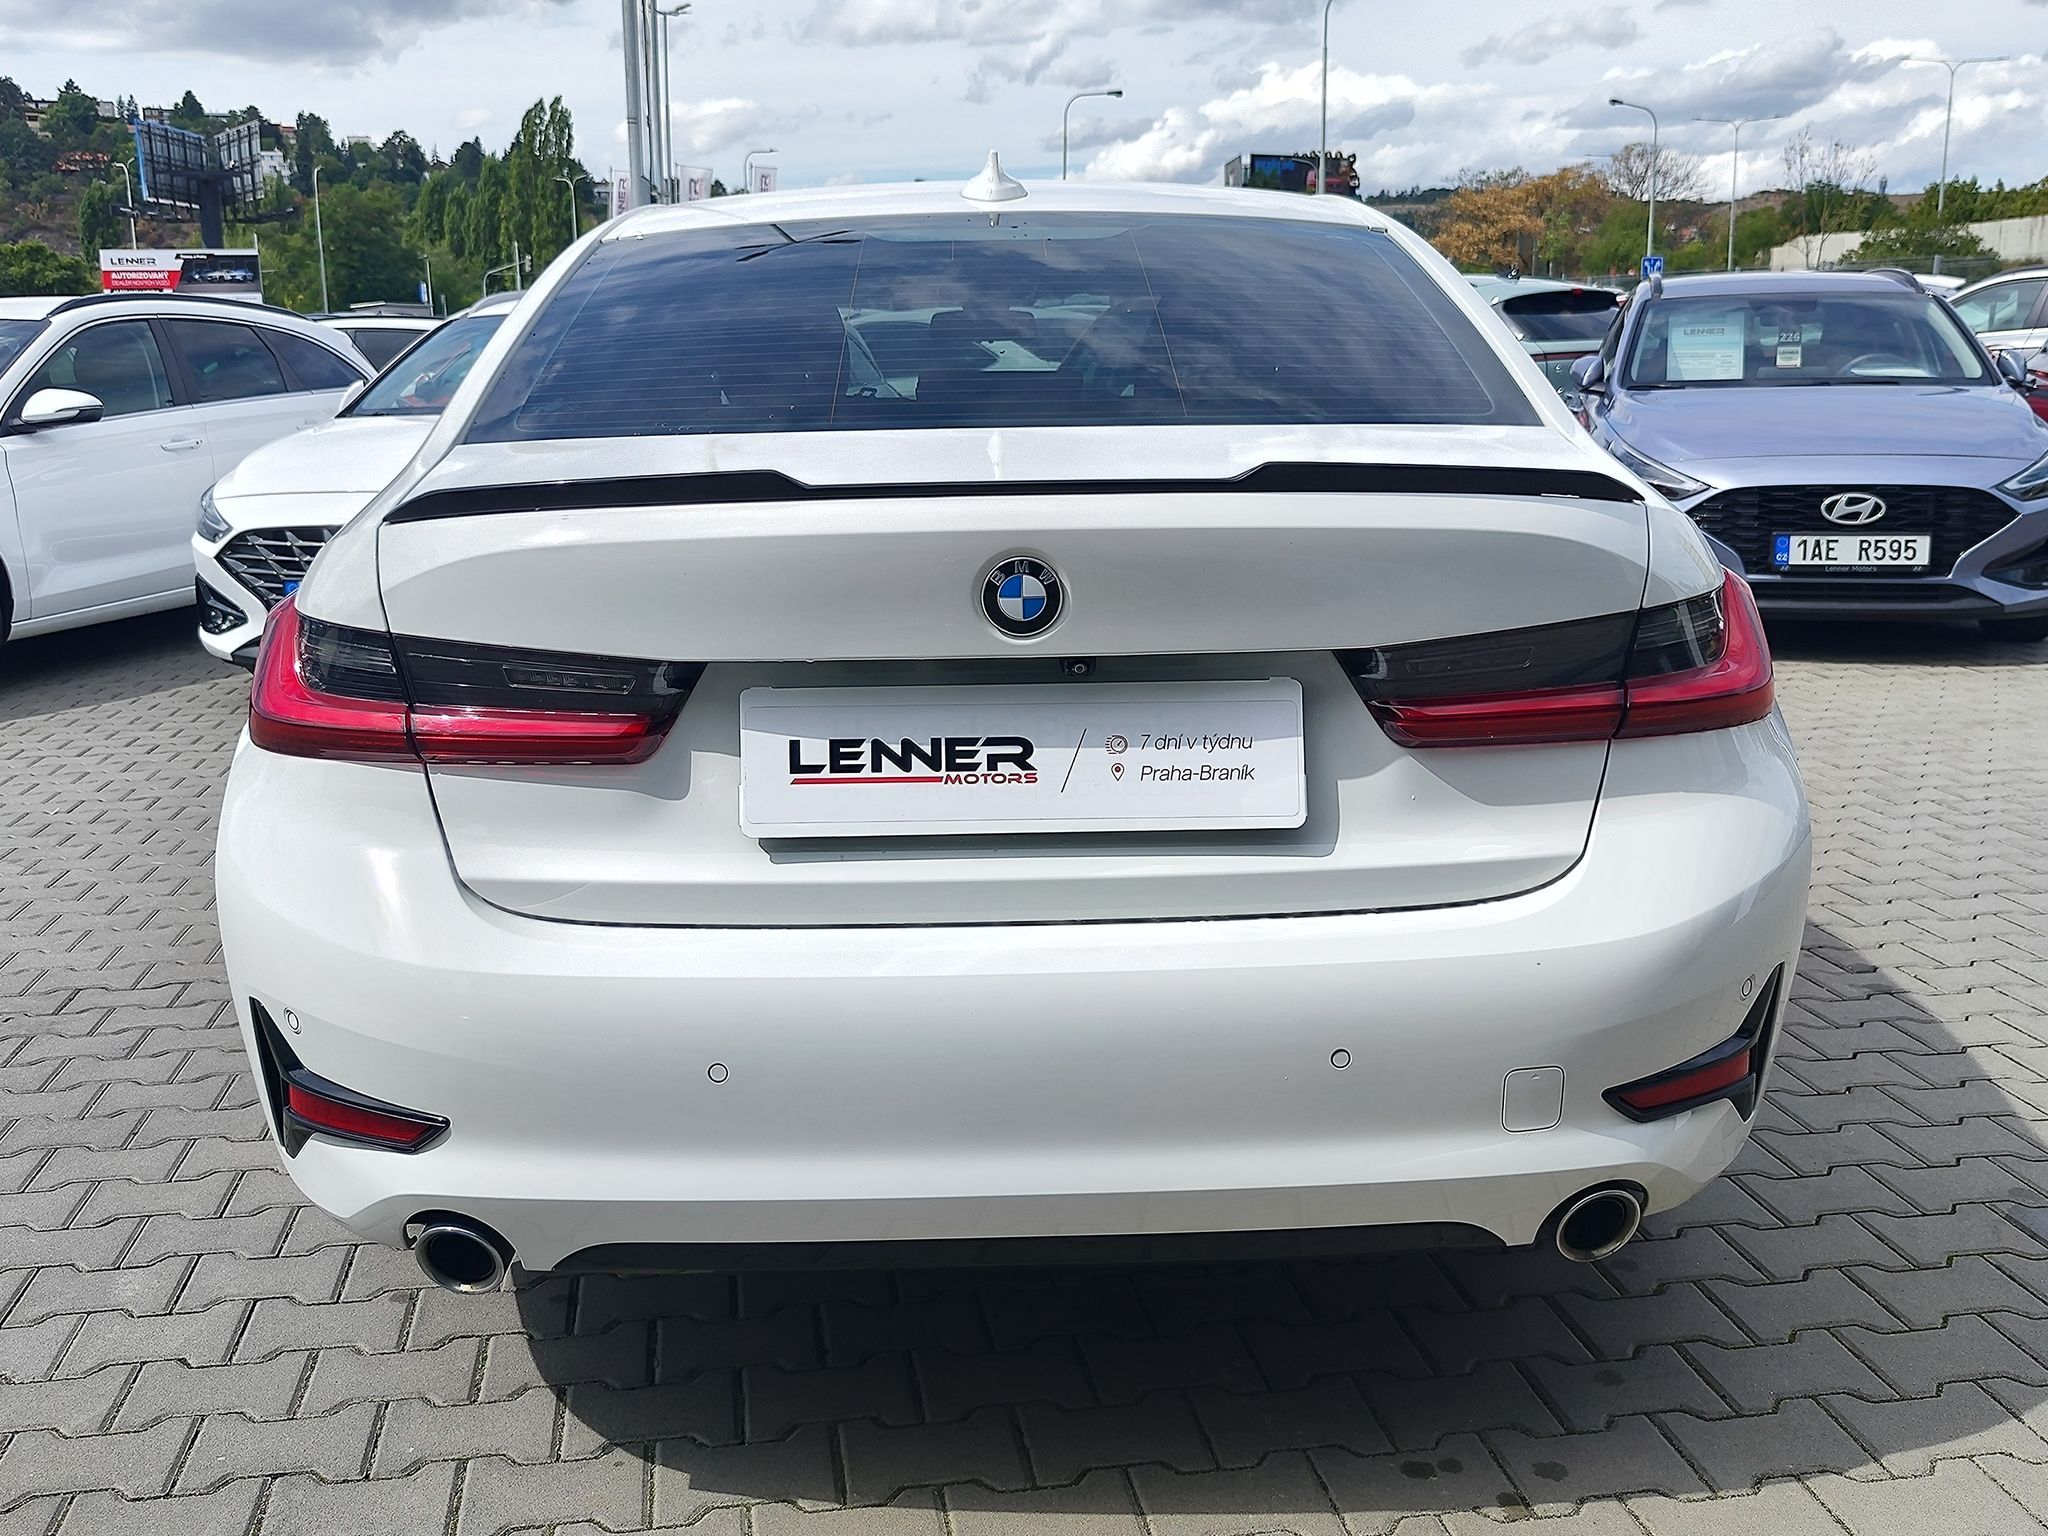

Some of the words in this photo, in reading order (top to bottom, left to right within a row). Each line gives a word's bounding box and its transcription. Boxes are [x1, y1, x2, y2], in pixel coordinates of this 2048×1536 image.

[110, 257, 157, 266] LENNER
[1683, 327, 1726, 336] LENNER
[1797, 539, 1839, 561] 1AE
[1858, 539, 1917, 561] R595
[990, 560, 1055, 586] BMW
[1140, 734, 1151, 750] 7
[1155, 733, 1184, 750] dní
[1187, 737, 1197, 749] v
[1202, 732, 1253, 753] týdnu
[789, 735, 1038, 774] LENNER
[944, 773, 1039, 785] MOTORS
[1140, 763, 1256, 782] Praha-Braník
